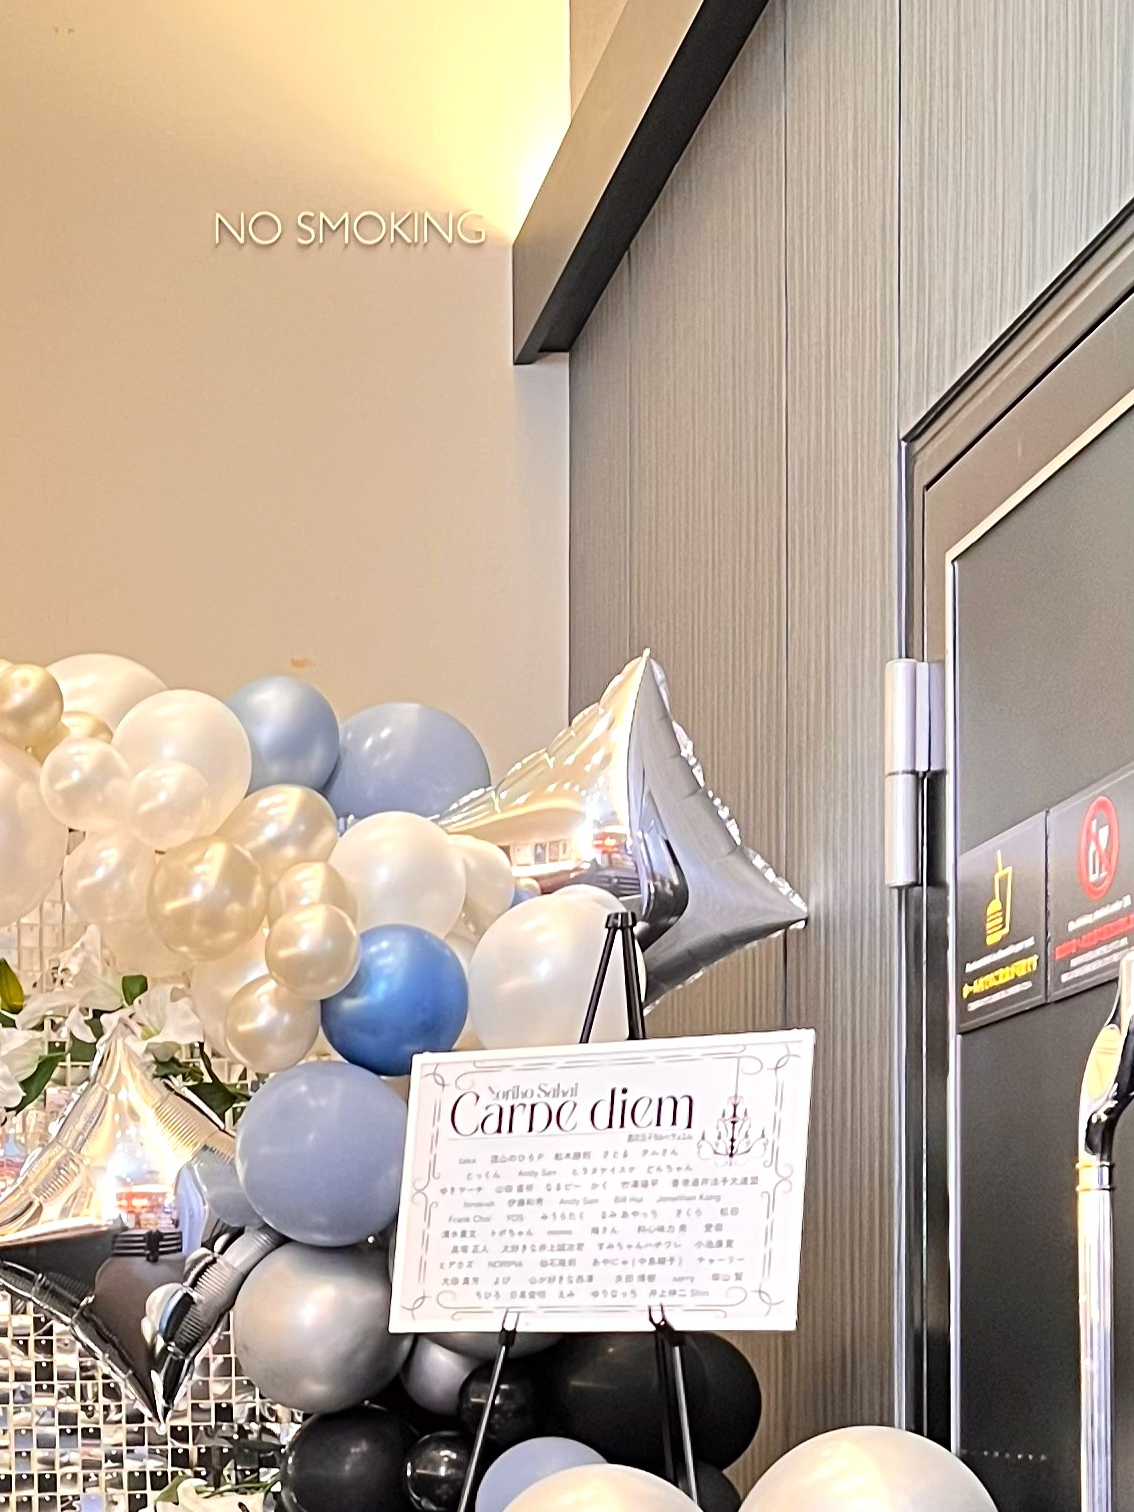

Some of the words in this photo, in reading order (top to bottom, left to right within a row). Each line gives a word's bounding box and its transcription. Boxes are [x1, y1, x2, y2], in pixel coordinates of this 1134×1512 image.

[215, 210, 282, 245] NO
[297, 210, 487, 246] SMOKING
[449, 1090, 578, 1137] Carpe
[589, 1086, 695, 1131] diem
